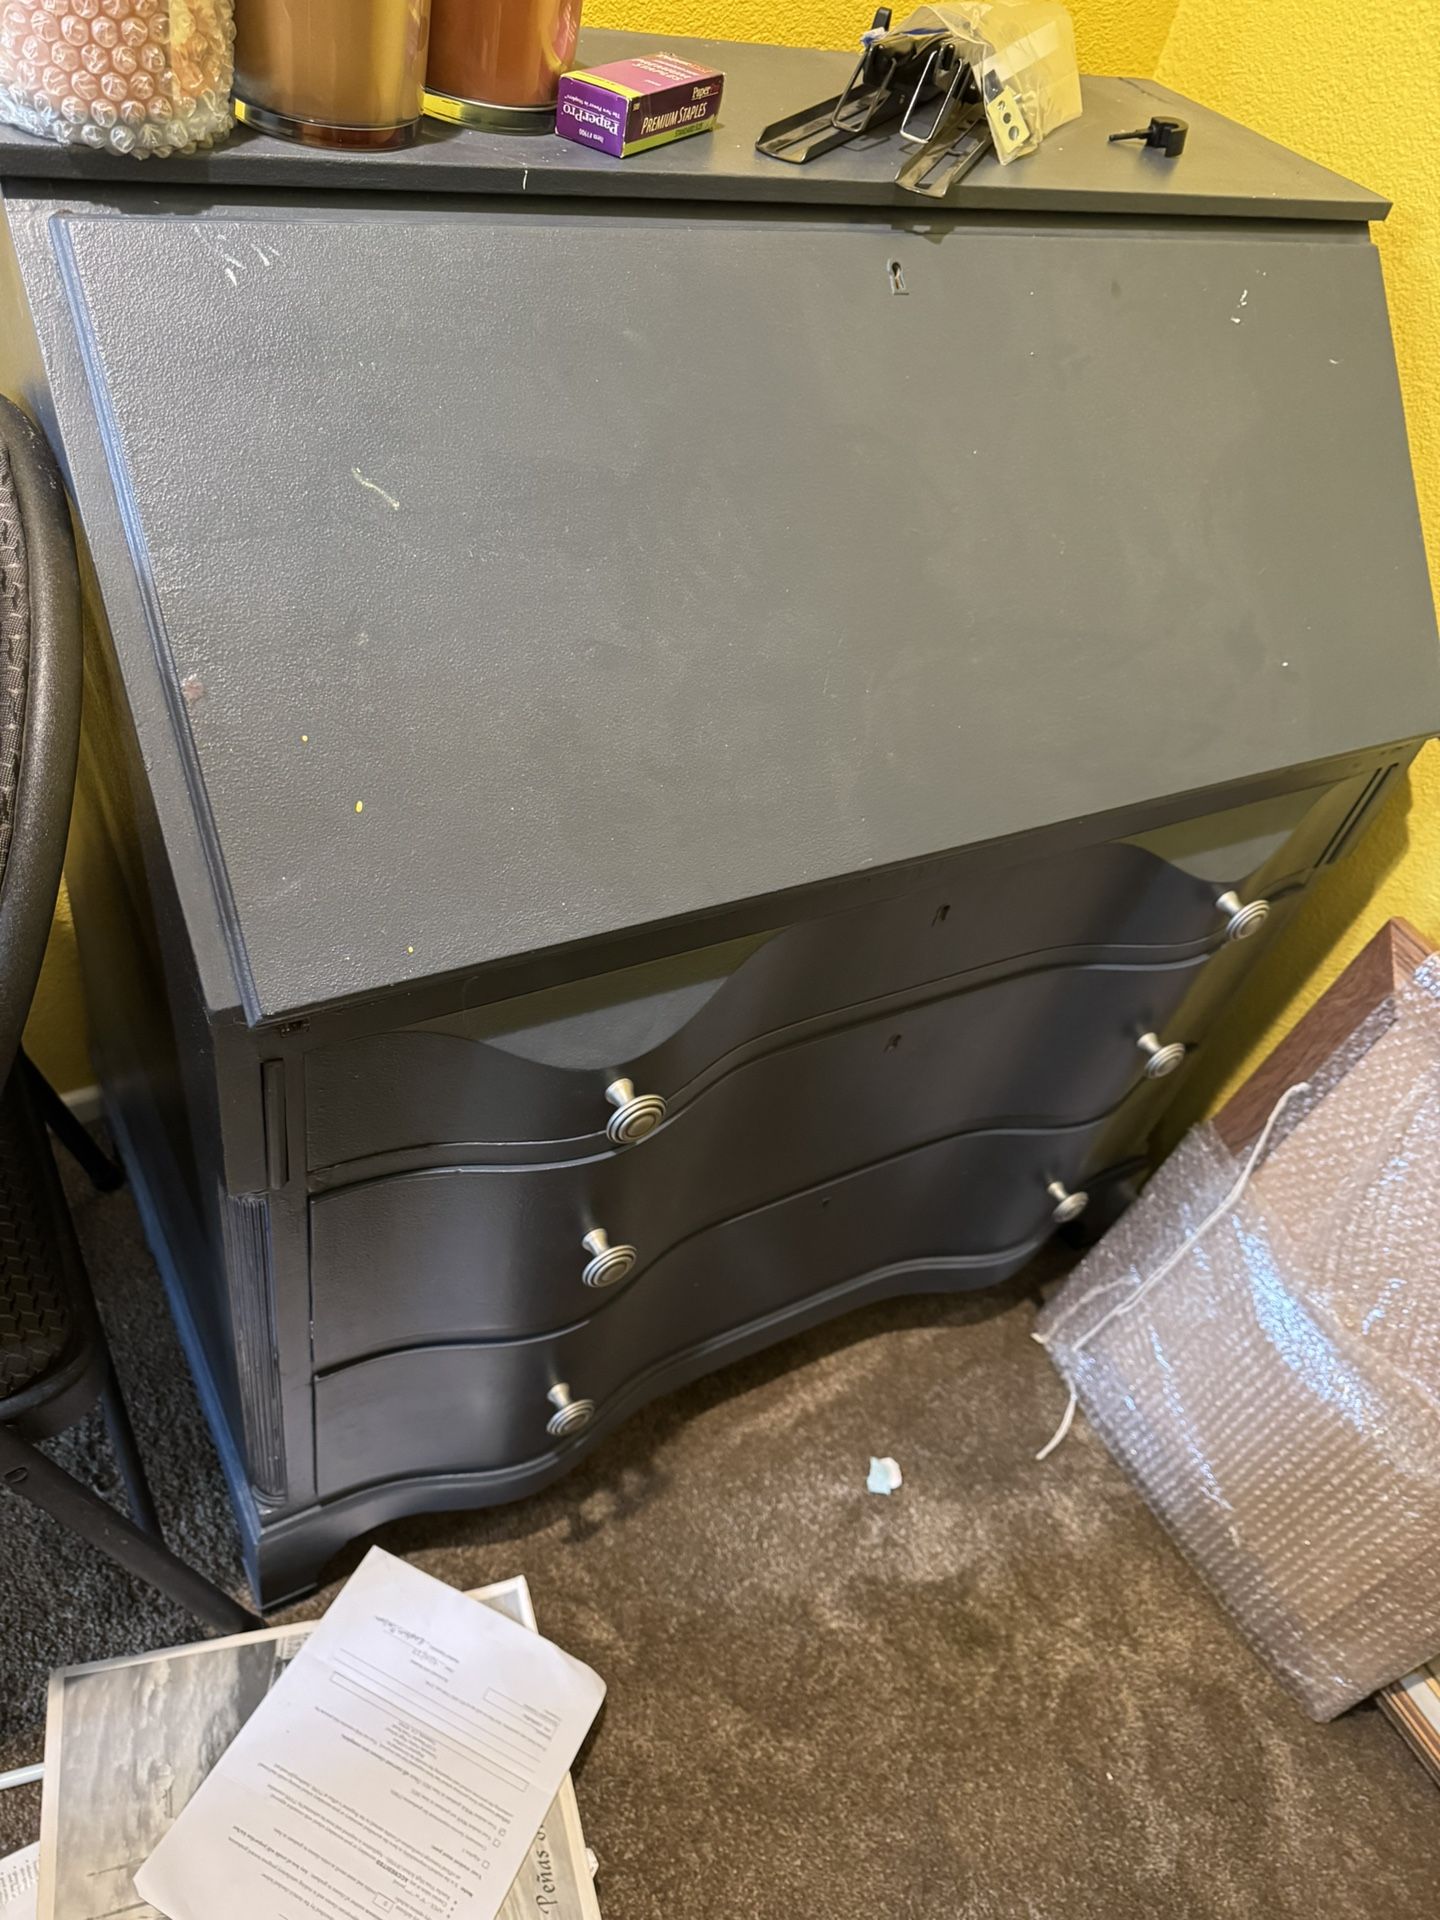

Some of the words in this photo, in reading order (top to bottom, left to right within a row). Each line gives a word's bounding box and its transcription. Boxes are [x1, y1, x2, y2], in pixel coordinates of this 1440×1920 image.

[563, 104, 620, 136] PaperPro
[589, 102, 603, 112] Power
[641, 111, 678, 135] PREMIUM
[677, 102, 708, 124] STAPLES
[593, 132, 605, 143] Item
[373, 1858, 410, 1883] ACCREDITED
[536, 1849, 559, 1916] Peñas
